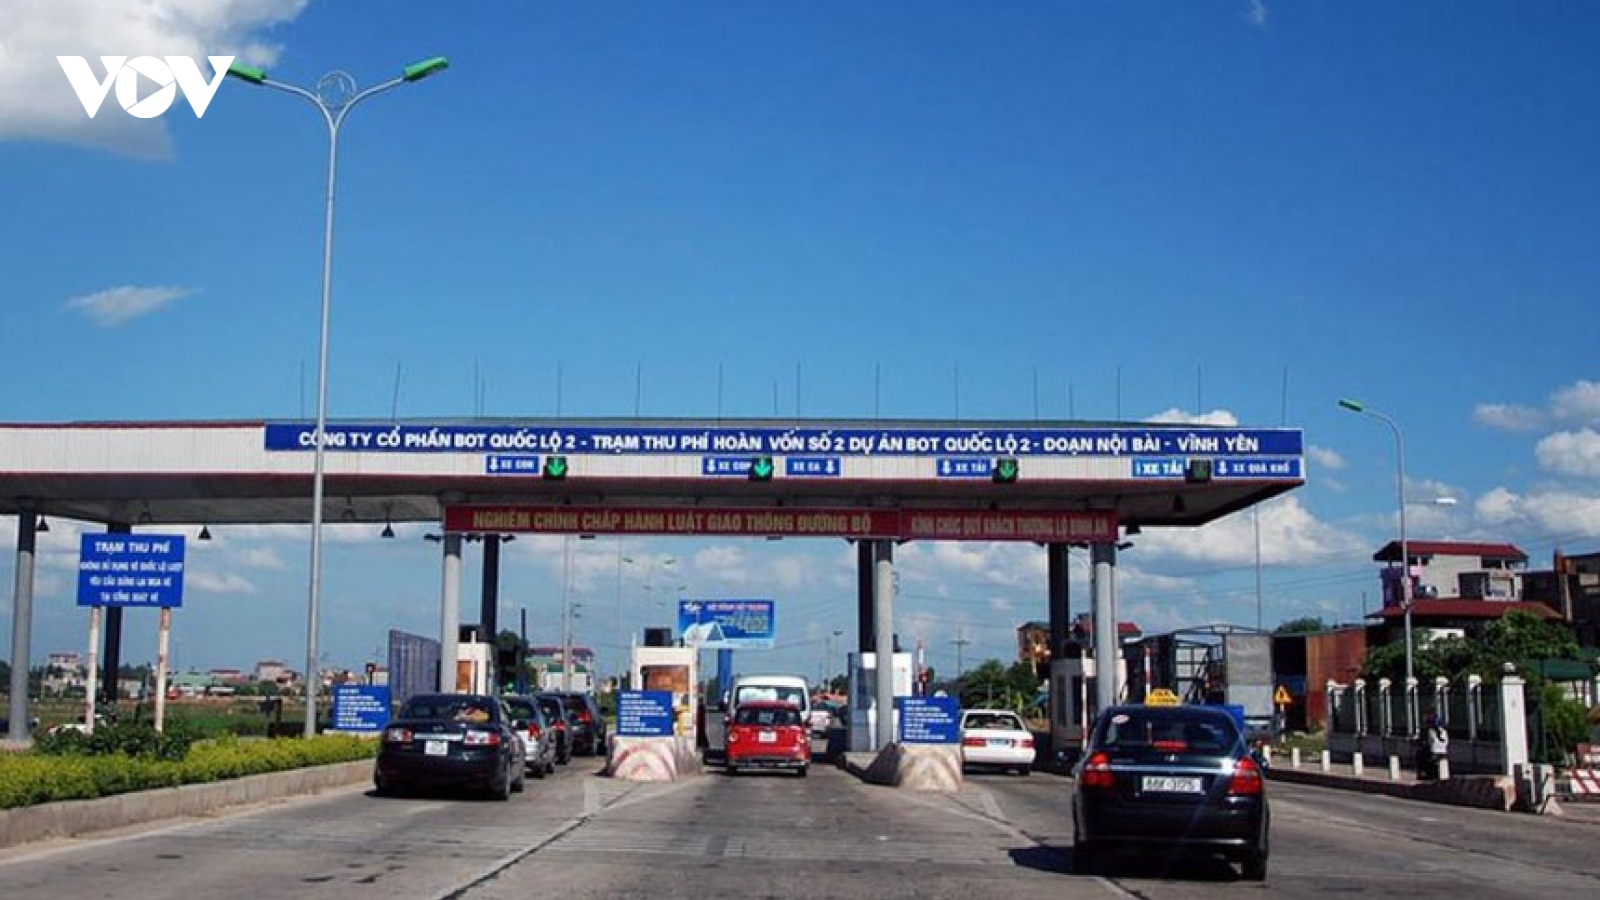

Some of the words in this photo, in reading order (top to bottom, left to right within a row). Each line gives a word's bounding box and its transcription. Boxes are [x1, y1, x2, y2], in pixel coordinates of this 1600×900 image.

[350, 432, 372, 447] TY
[454, 433, 487, 448] BOT
[490, 428, 538, 449] QUỐC
[540, 431, 562, 453] LỘ
[565, 434, 576, 449] 2
[592, 434, 639, 454] TRẠM
[642, 434, 676, 450] THU
[681, 431, 709, 450] PHÍ
[714, 432, 762, 451] HOÀN
[769, 428, 804, 451] VỐN
[808, 430, 833, 451] SỐ
[834, 435, 845, 451] 2
[850, 435, 875, 455] DỰ
[878, 433, 903, 451] ÁN
[906, 436, 940, 451] BOT
[944, 431, 993, 452] QUỐC
[996, 433, 1017, 456] LỘ
[1019, 437, 1030, 452] 2
[1043, 436, 1093, 456] ĐOẠN
[1097, 433, 1128, 456] NỘI
[1132, 433, 1160, 452] BÀI
[1177, 432, 1219, 452] VĨNH
[1224, 432, 1259, 452] YÊN
[95, 541, 125, 555] TRẠM
[128, 541, 149, 554] THU
[152, 540, 171, 554] PHÍ
